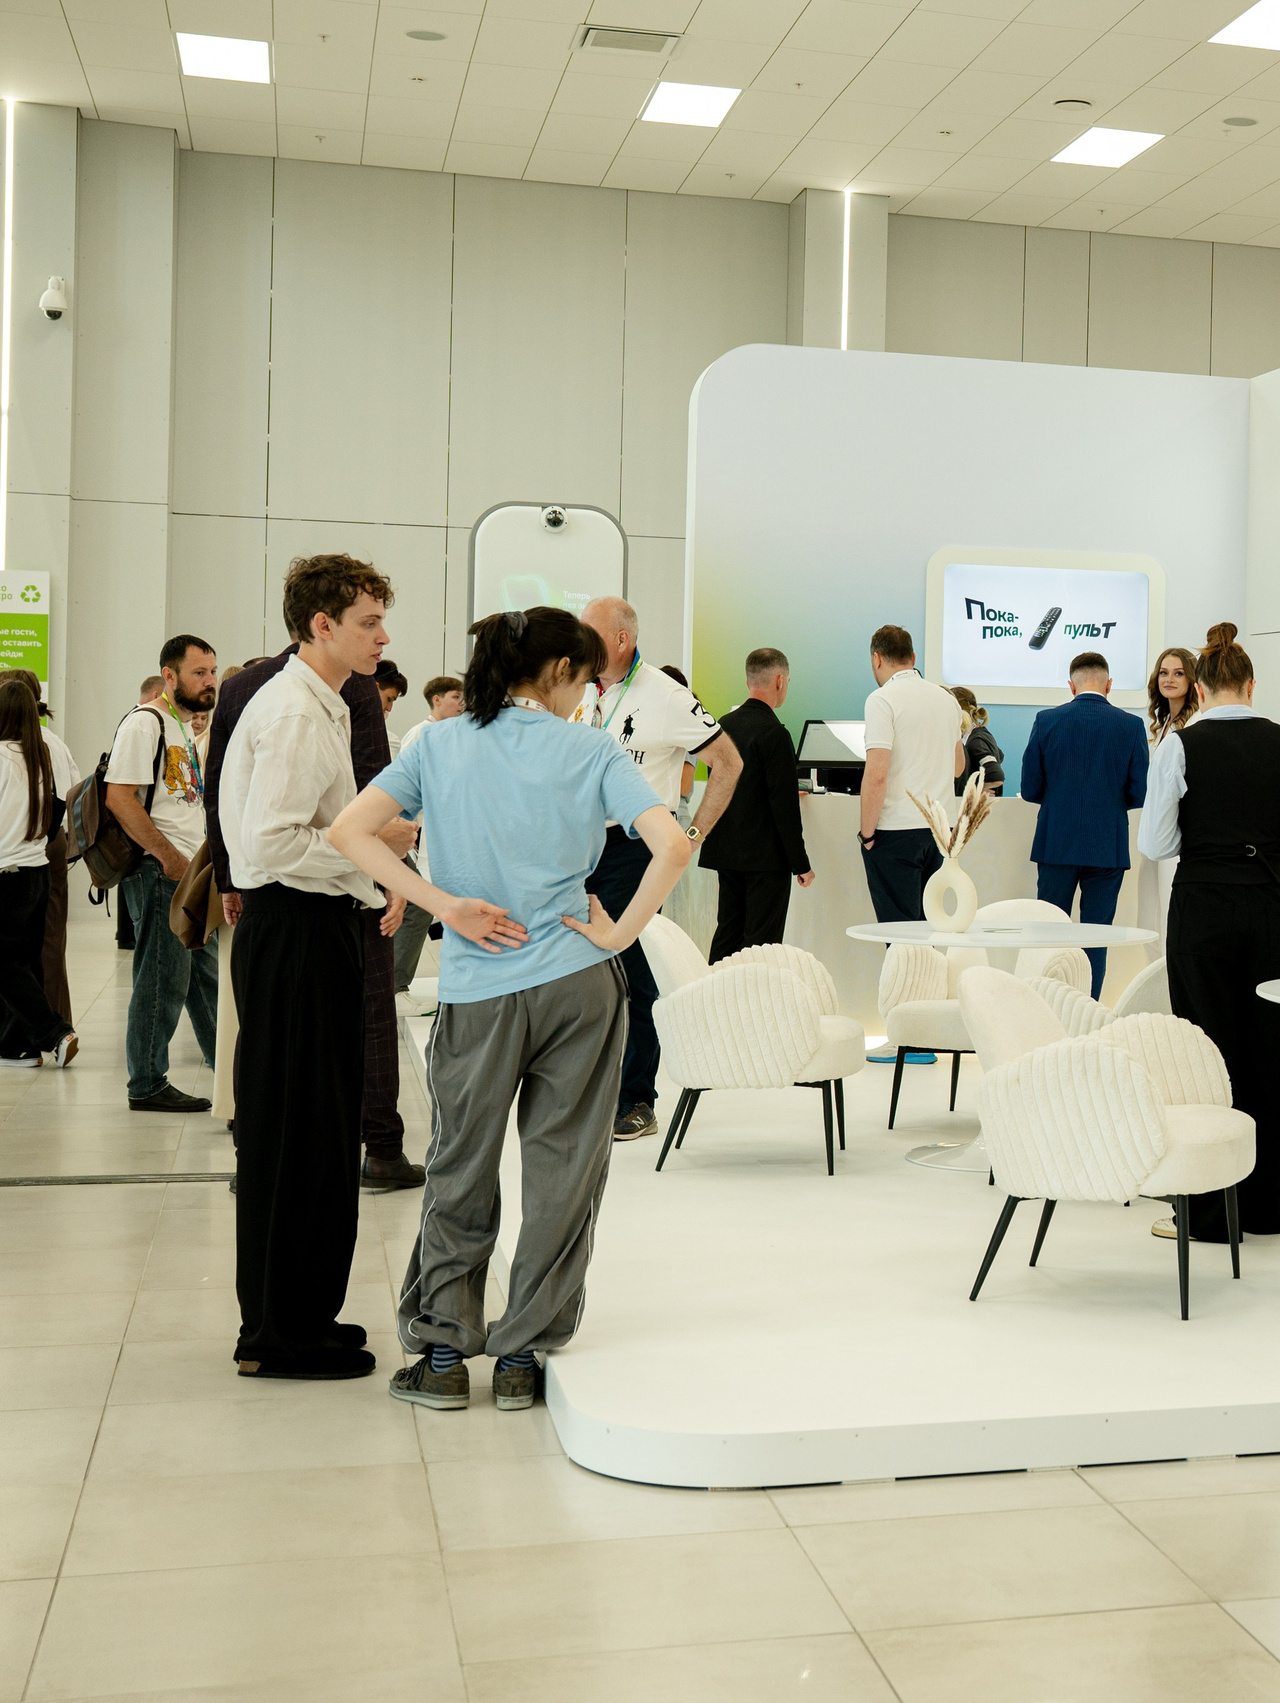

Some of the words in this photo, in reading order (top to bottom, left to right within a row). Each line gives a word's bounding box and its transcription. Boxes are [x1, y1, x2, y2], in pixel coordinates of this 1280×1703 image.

[964, 597, 1019, 623] Пока-
[11, 628, 37, 637] гости,
[982, 625, 1023, 639] пока,
[1063, 621, 1117, 640] пульт
[2, 639, 42, 648] оставить
[0, 650, 24, 658] ейдж
